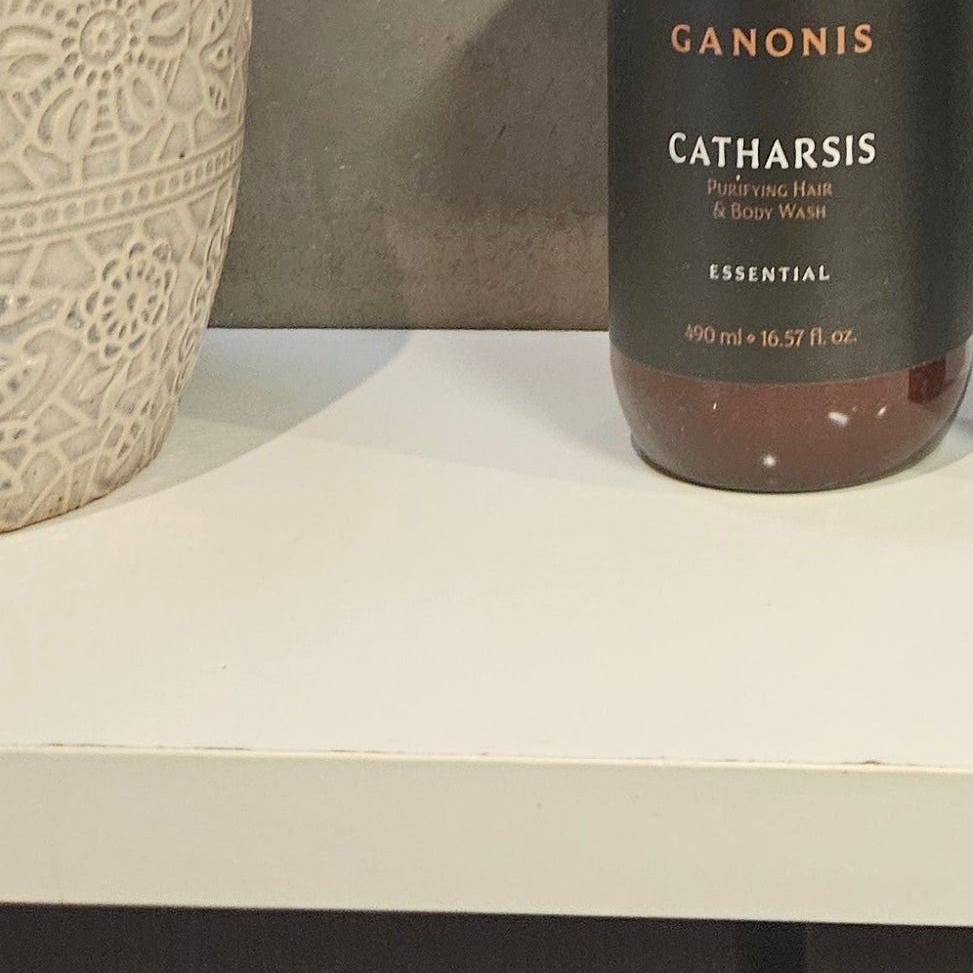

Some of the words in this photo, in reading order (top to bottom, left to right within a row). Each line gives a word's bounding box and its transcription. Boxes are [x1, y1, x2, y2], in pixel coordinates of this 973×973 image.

[670, 24, 873, 58] GANONIS
[668, 132, 876, 169] CATHARSIS
[793, 180, 832, 197] HAIR
[713, 200, 725, 219] &
[731, 201, 773, 220] BODY
[779, 203, 826, 220] WASH
[709, 264, 829, 282] ESSENTIAL
[685, 324, 716, 344] 490
[720, 328, 742, 345] ml
[761, 329, 804, 348] 16.57
[810, 327, 826, 346] fl.
[831, 329, 857, 346] oz.
